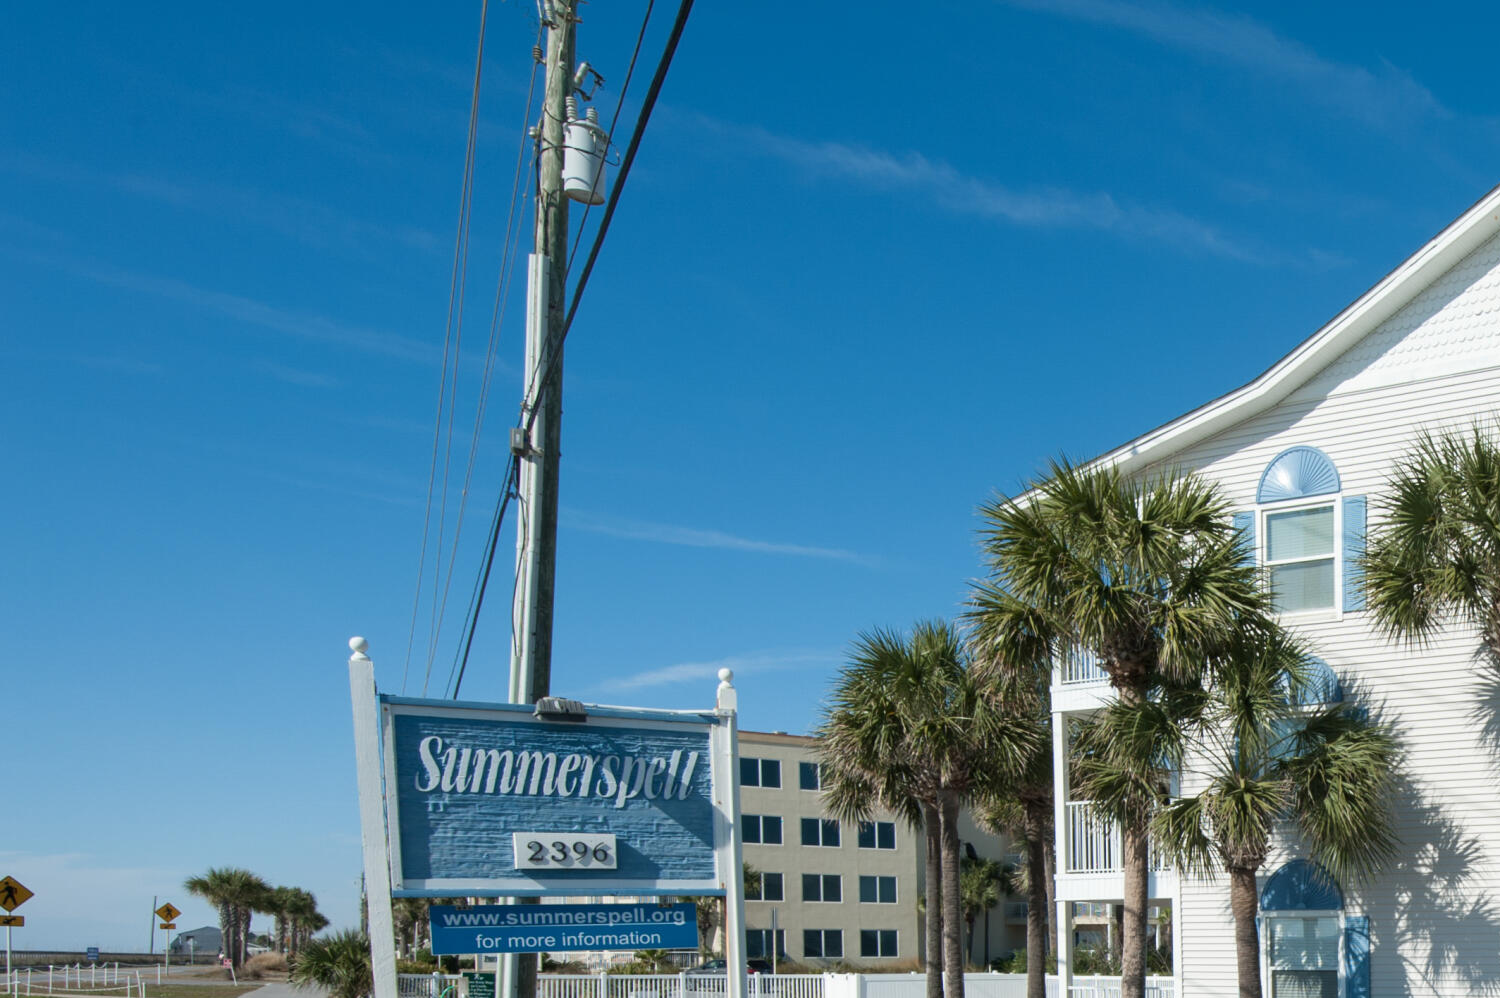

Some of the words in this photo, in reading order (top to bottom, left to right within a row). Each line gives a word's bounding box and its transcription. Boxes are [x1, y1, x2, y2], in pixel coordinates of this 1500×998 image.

[415, 735, 698, 808] Summerspell
[527, 841, 608, 863] 2396
[443, 907, 686, 926] www.summerspell.org
[475, 934, 501, 948] for
[508, 934, 556, 948] more
[562, 931, 661, 947] information
